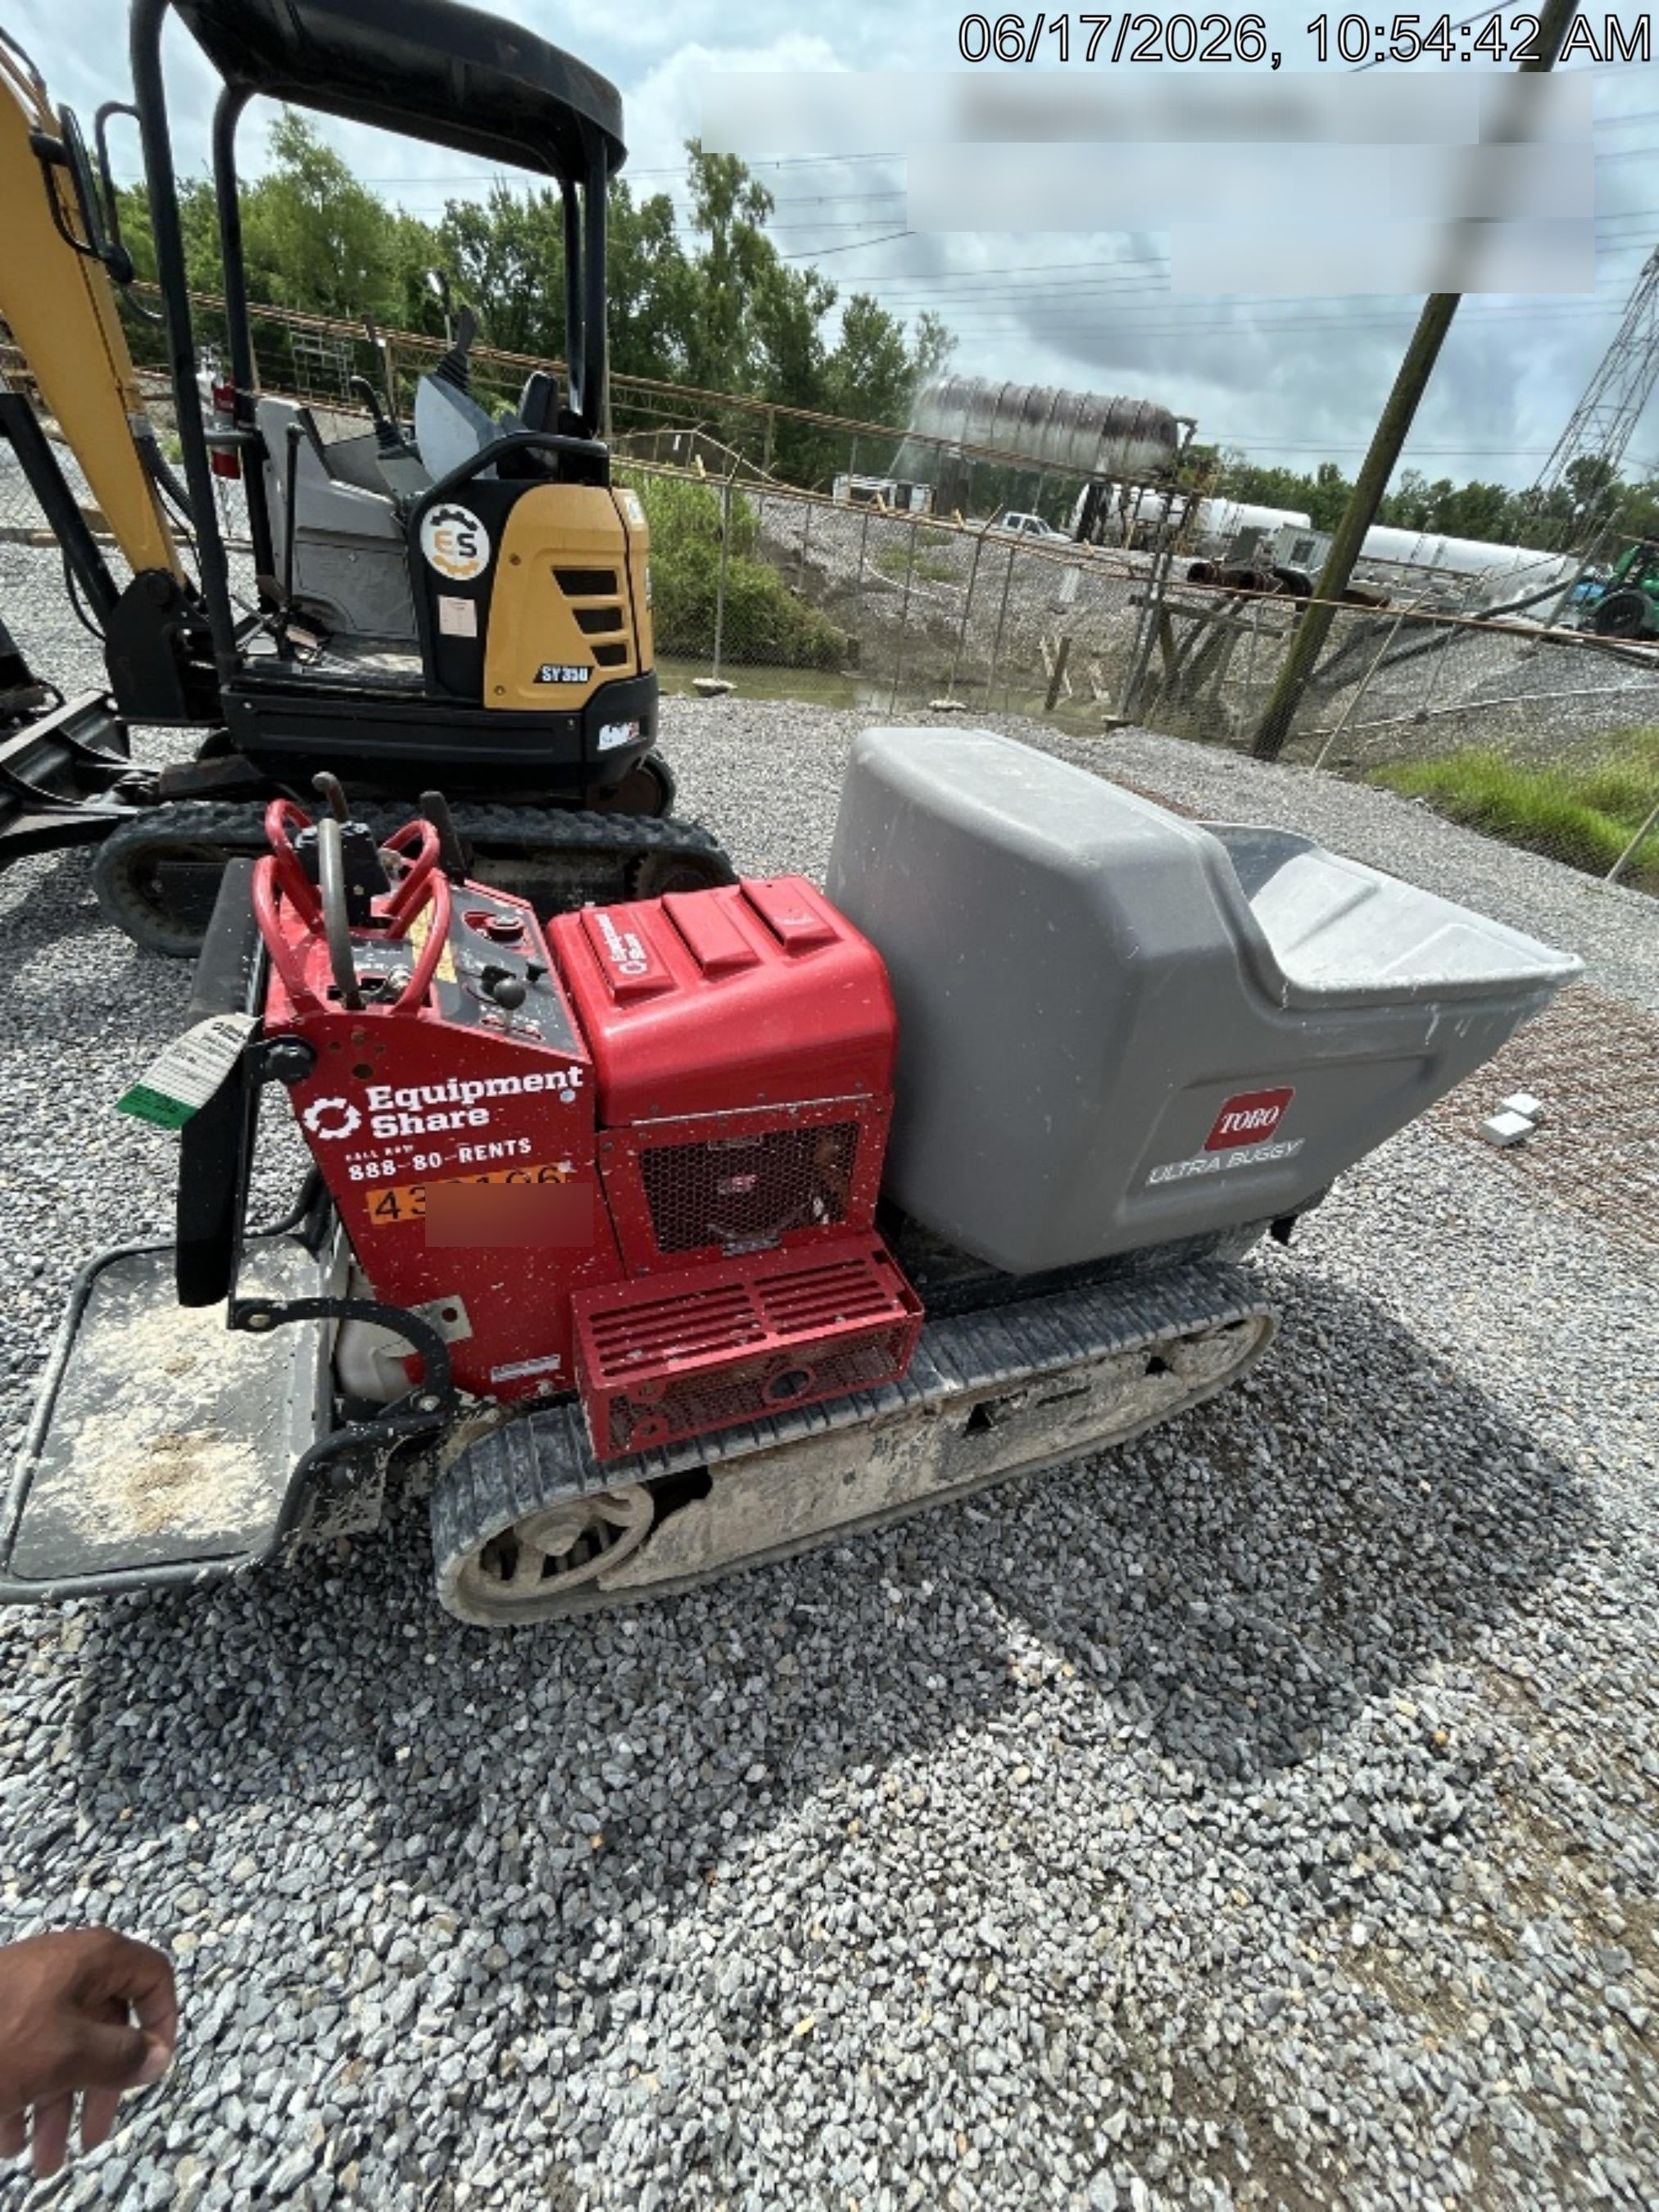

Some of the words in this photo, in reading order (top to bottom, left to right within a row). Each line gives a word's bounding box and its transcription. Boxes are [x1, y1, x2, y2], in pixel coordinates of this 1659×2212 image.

[434, 530, 478, 558] ES
[365, 1065, 584, 1111] Equipment
[370, 1107, 491, 1139] Share
[1218, 1104, 1280, 1135] TORO
[348, 1137, 532, 1181] 888-80-RENTS
[1146, 1156, 1222, 1185] ULTRA
[1226, 1138, 1306, 1168] BUGGY
